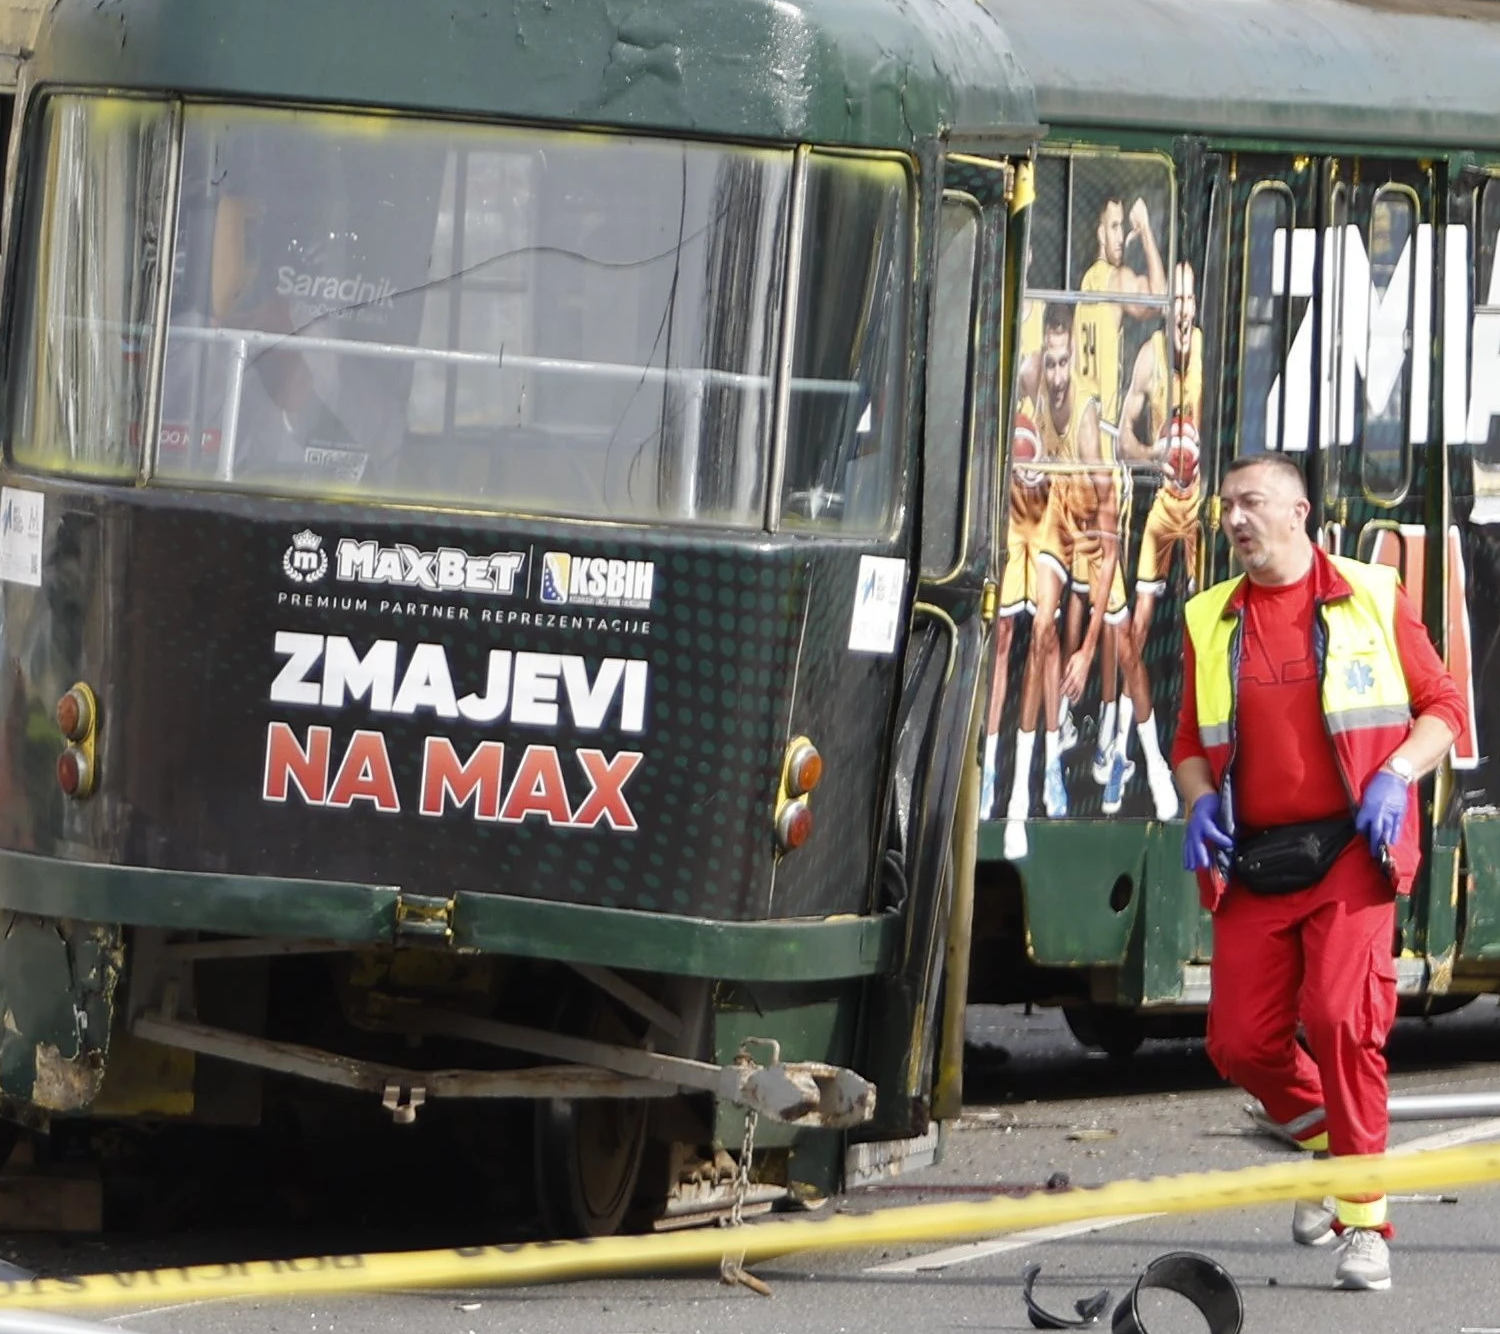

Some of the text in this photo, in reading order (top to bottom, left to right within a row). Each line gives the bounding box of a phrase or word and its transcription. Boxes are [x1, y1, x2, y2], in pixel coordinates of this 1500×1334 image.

[277, 592, 652, 635] PREMIUM PARTNER REPREZENTACIJE
[569, 555, 654, 599] KSBIH
[270, 630, 649, 733] ZMAJEVI
[263, 720, 643, 831] NA MAX
